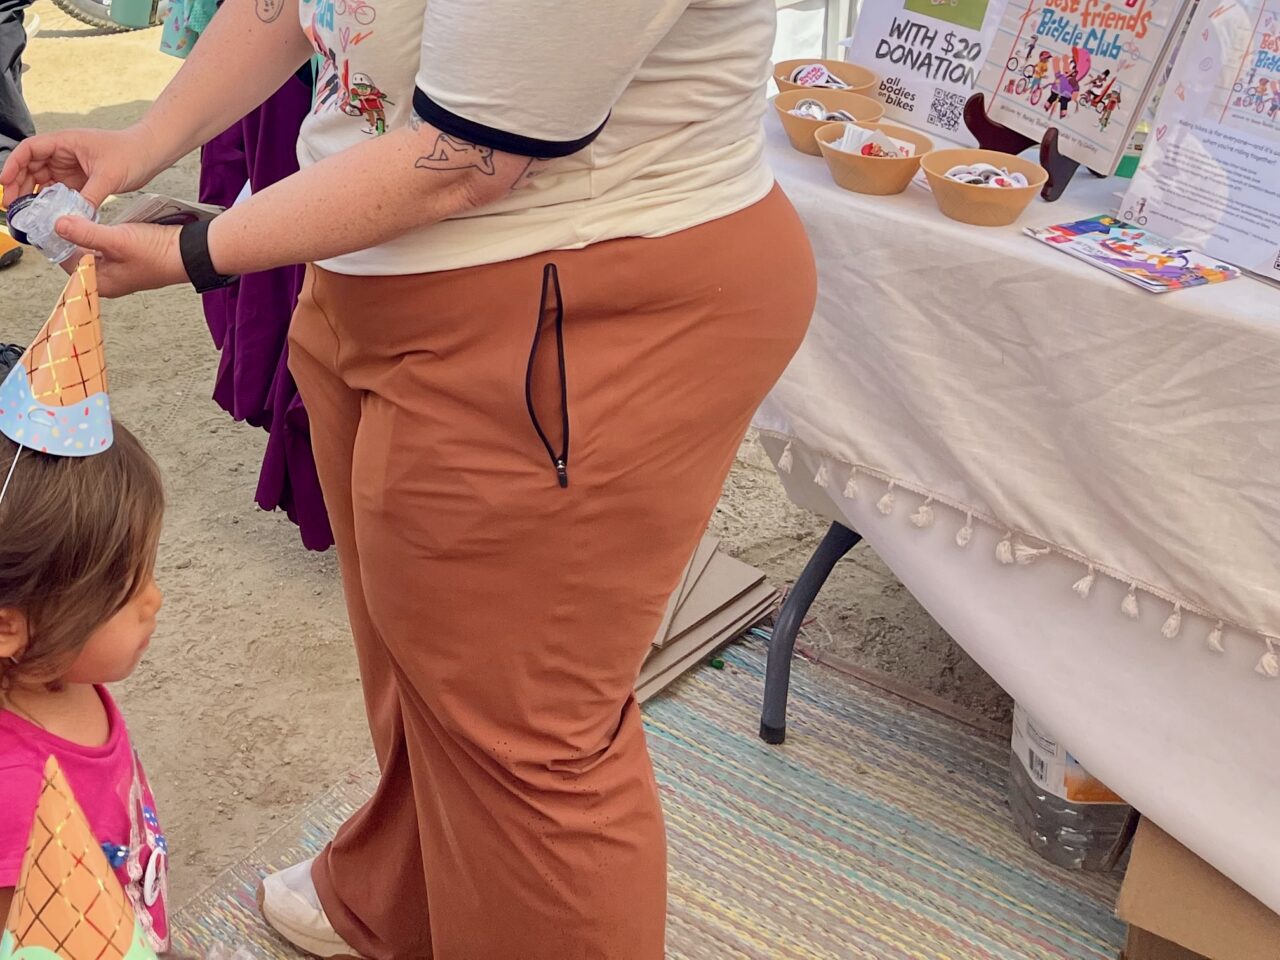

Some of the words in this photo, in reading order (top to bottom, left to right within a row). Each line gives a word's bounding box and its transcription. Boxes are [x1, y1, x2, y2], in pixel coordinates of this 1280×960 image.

[889, 17, 938, 50] WITH
[941, 31, 982, 61] $20
[1037, 8, 1083, 47] Bicycle
[1083, 28, 1121, 60] Club
[1260, 33, 1280, 52] Bes
[875, 39, 981, 90] DONATION
[879, 81, 917, 101] bodies
[886, 76, 900, 87] all
[886, 95, 915, 112] bikes
